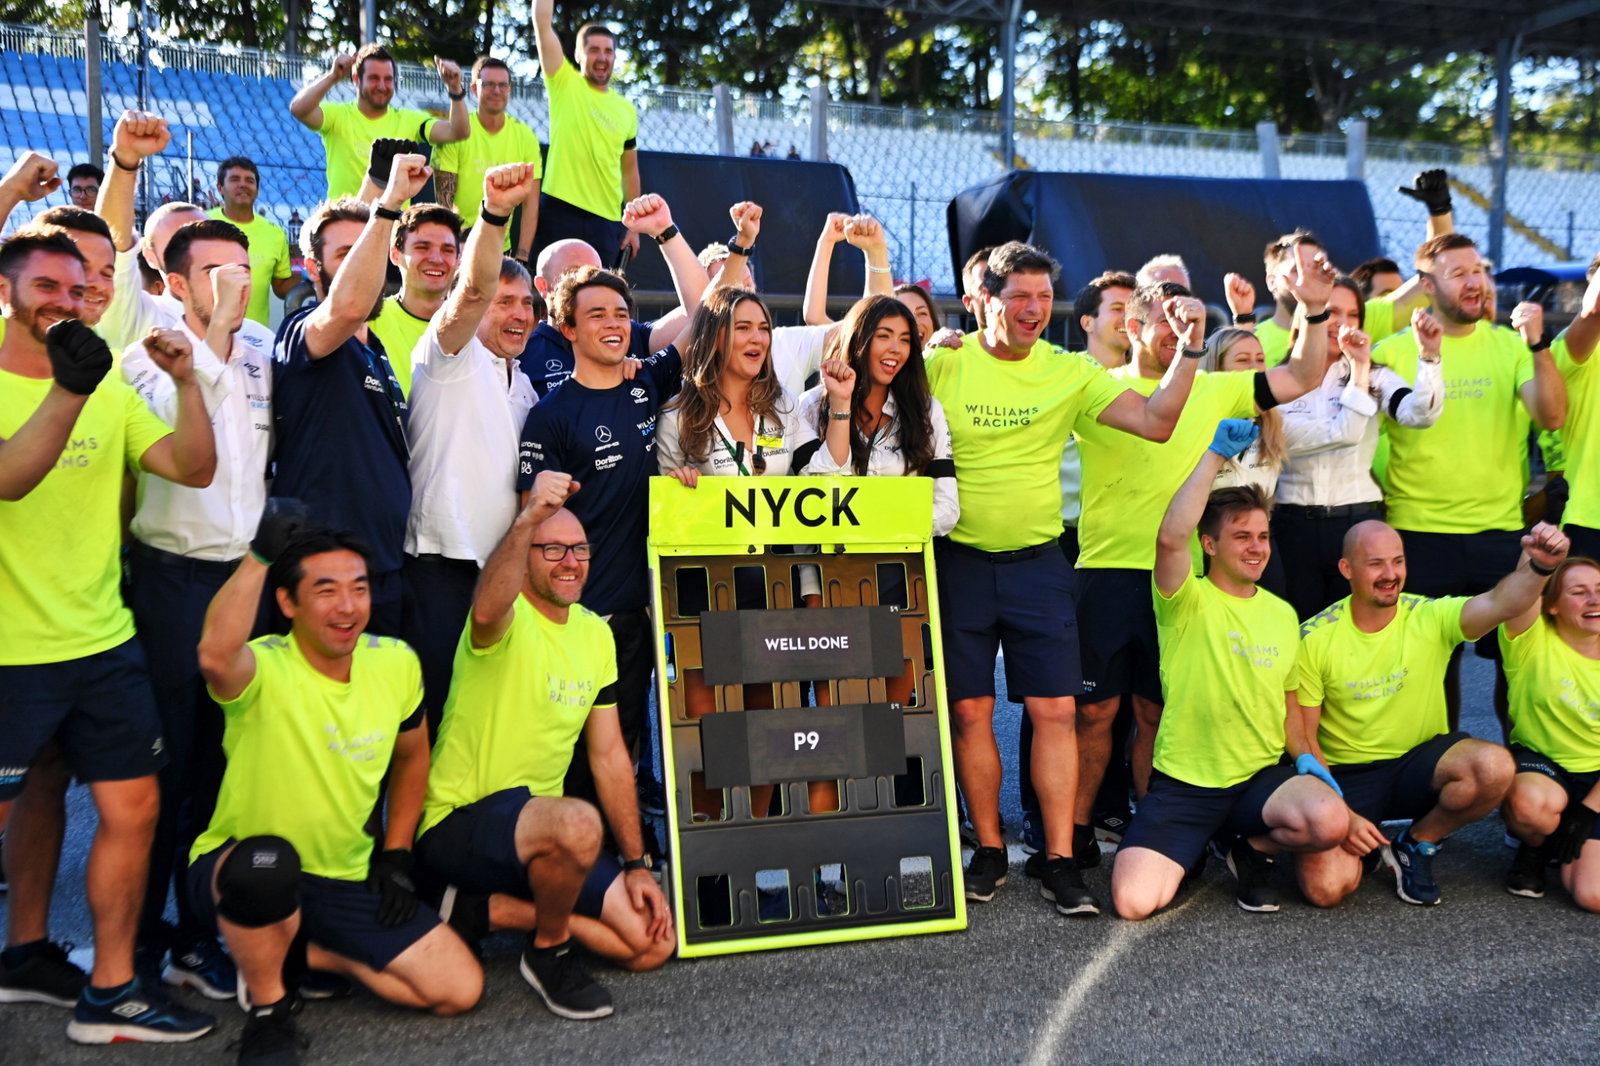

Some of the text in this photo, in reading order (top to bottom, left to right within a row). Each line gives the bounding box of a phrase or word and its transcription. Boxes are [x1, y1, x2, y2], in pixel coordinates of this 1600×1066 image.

[965, 404, 1038, 416] WILLIAMS
[973, 416, 1031, 427] RACING
[595, 454, 624, 467] Doritos
[725, 487, 861, 528] NYCK
[765, 636, 849, 651] WELL DONE
[794, 731, 820, 751] P9
